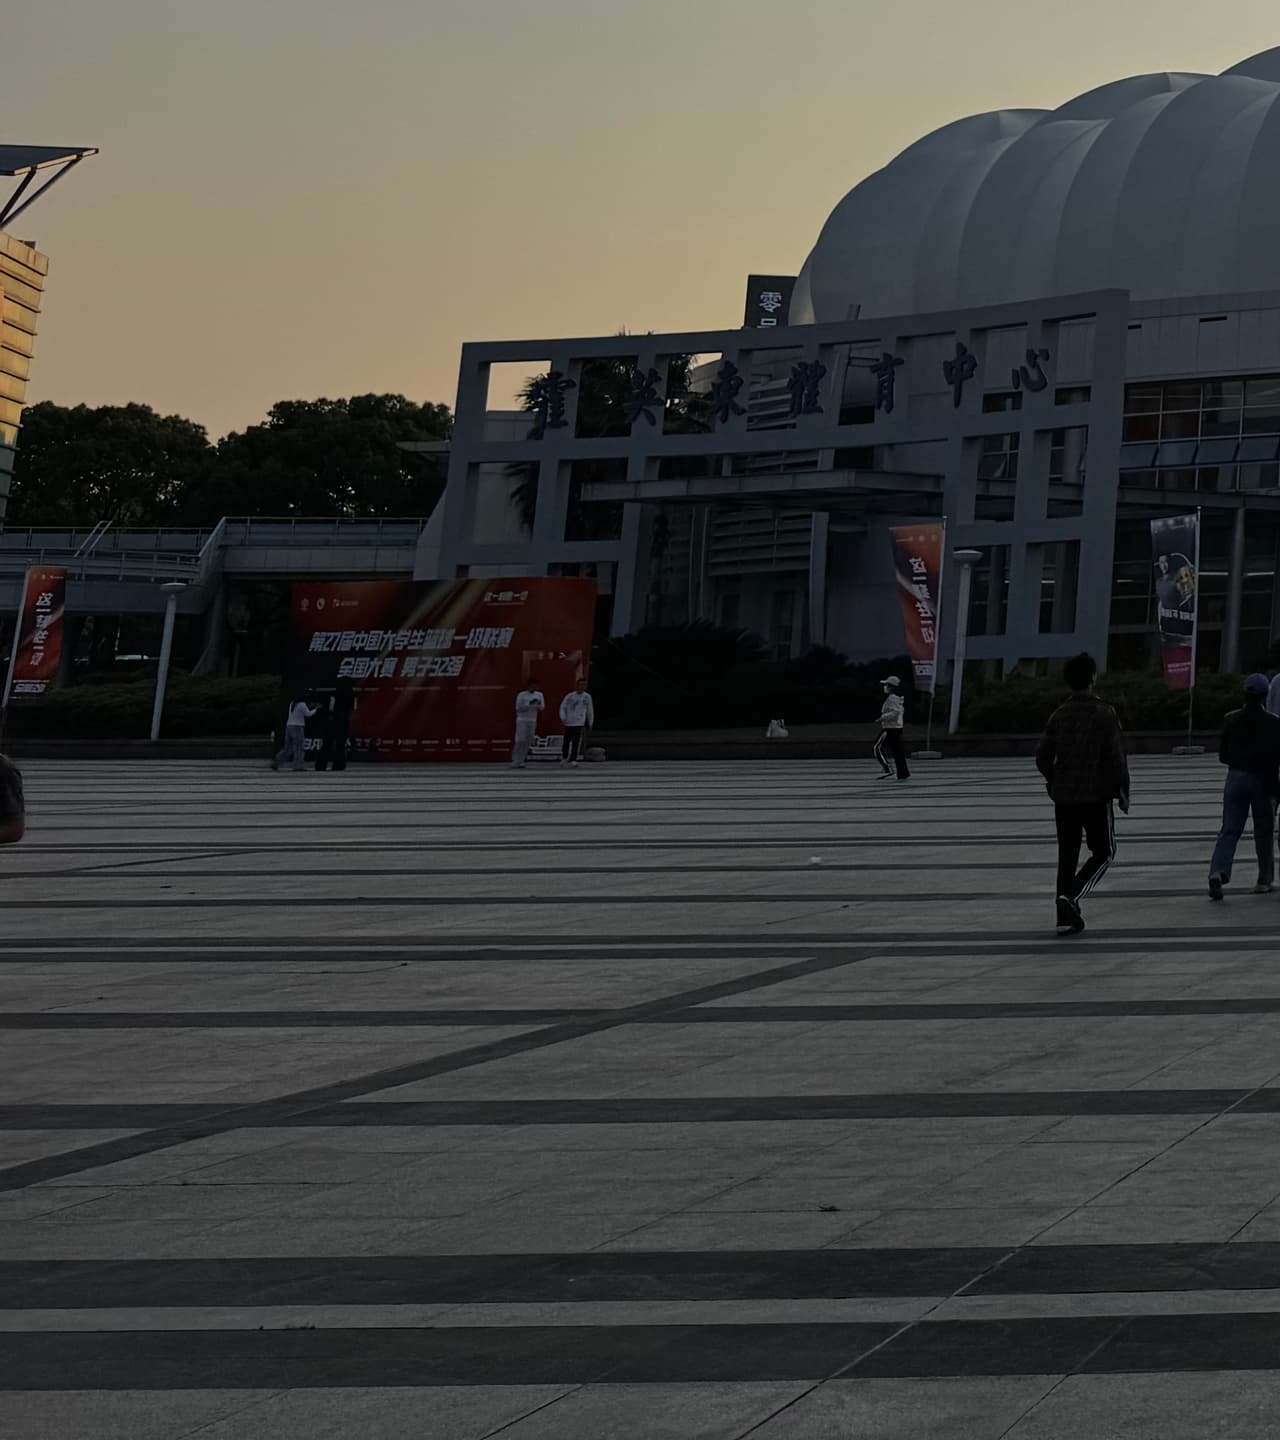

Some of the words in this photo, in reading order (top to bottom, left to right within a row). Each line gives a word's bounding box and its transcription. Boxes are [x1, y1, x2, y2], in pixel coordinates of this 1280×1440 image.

[336, 656, 398, 678] 全国大赛
[399, 655, 465, 678] 男子32强
